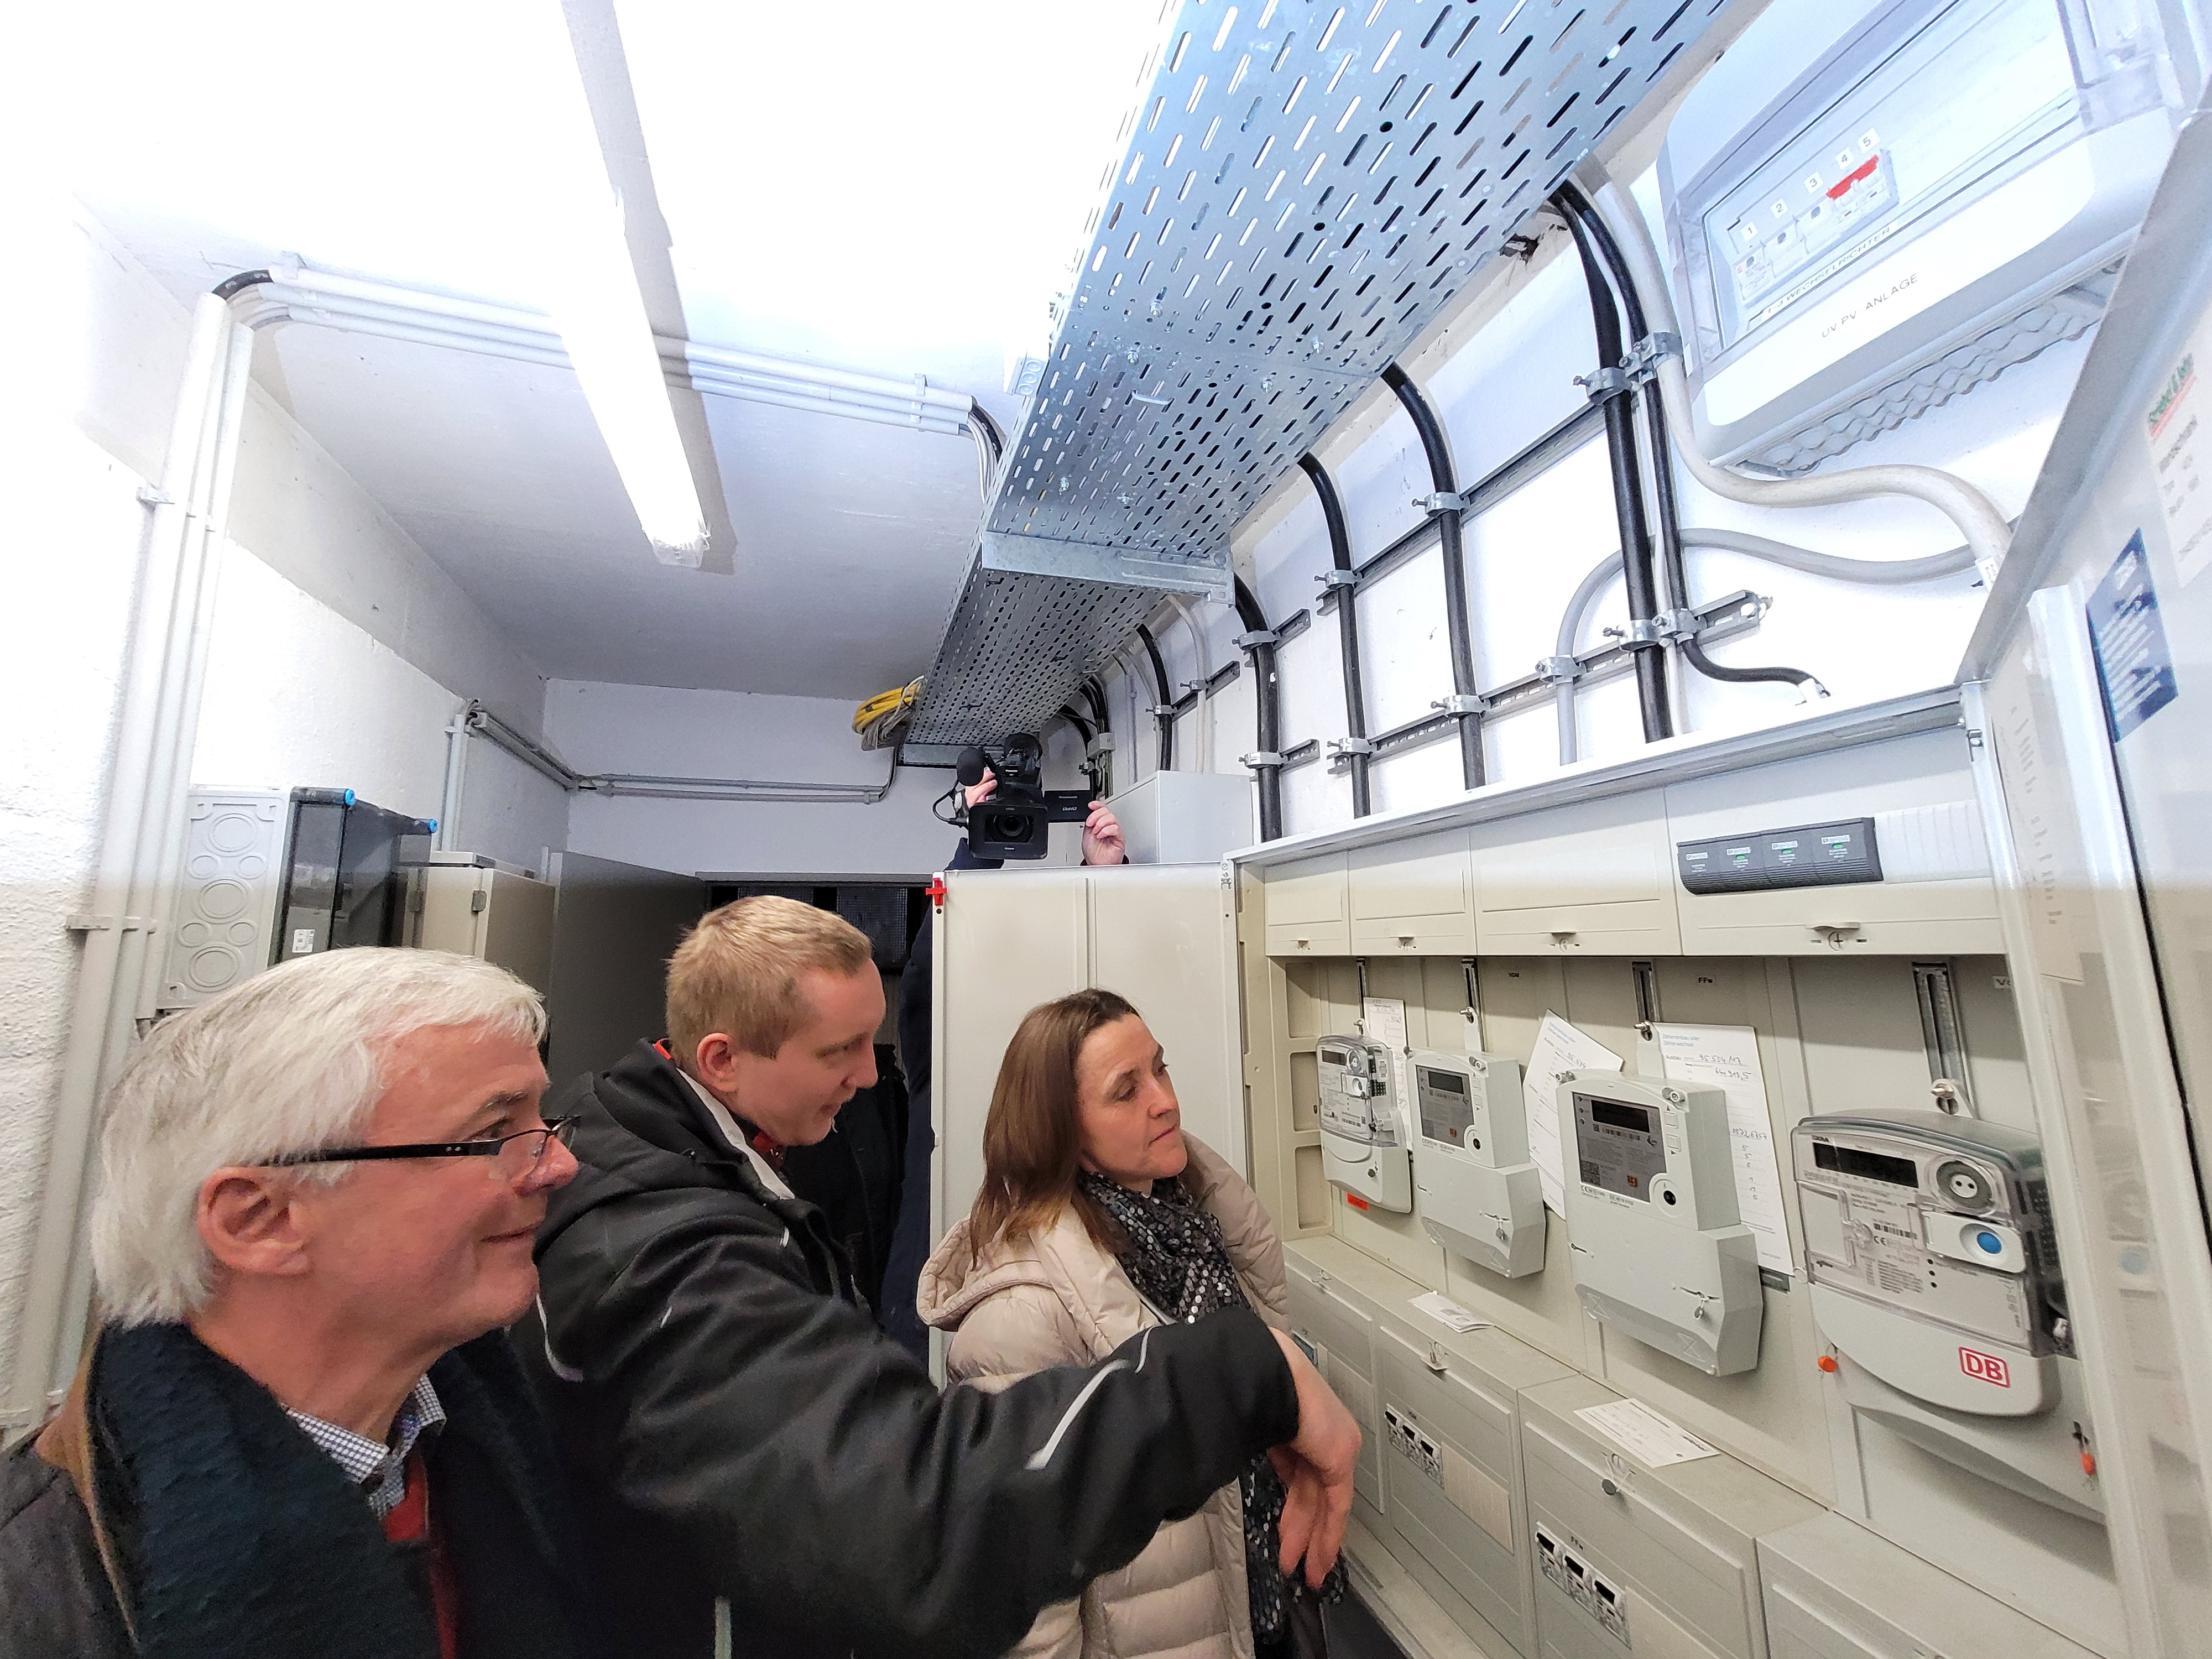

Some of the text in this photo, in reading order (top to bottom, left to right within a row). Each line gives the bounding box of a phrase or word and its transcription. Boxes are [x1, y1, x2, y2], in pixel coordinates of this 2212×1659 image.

[1863, 136, 1871, 147] 5
[1841, 154, 1848, 164] 4
[1809, 178, 1818, 187] 3
[1776, 203, 1783, 213] 2
[1786, 227, 1890, 301] WECHSELRICHTER
[1822, 322, 1837, 337] UV
[1965, 1353, 2003, 1381] DB
